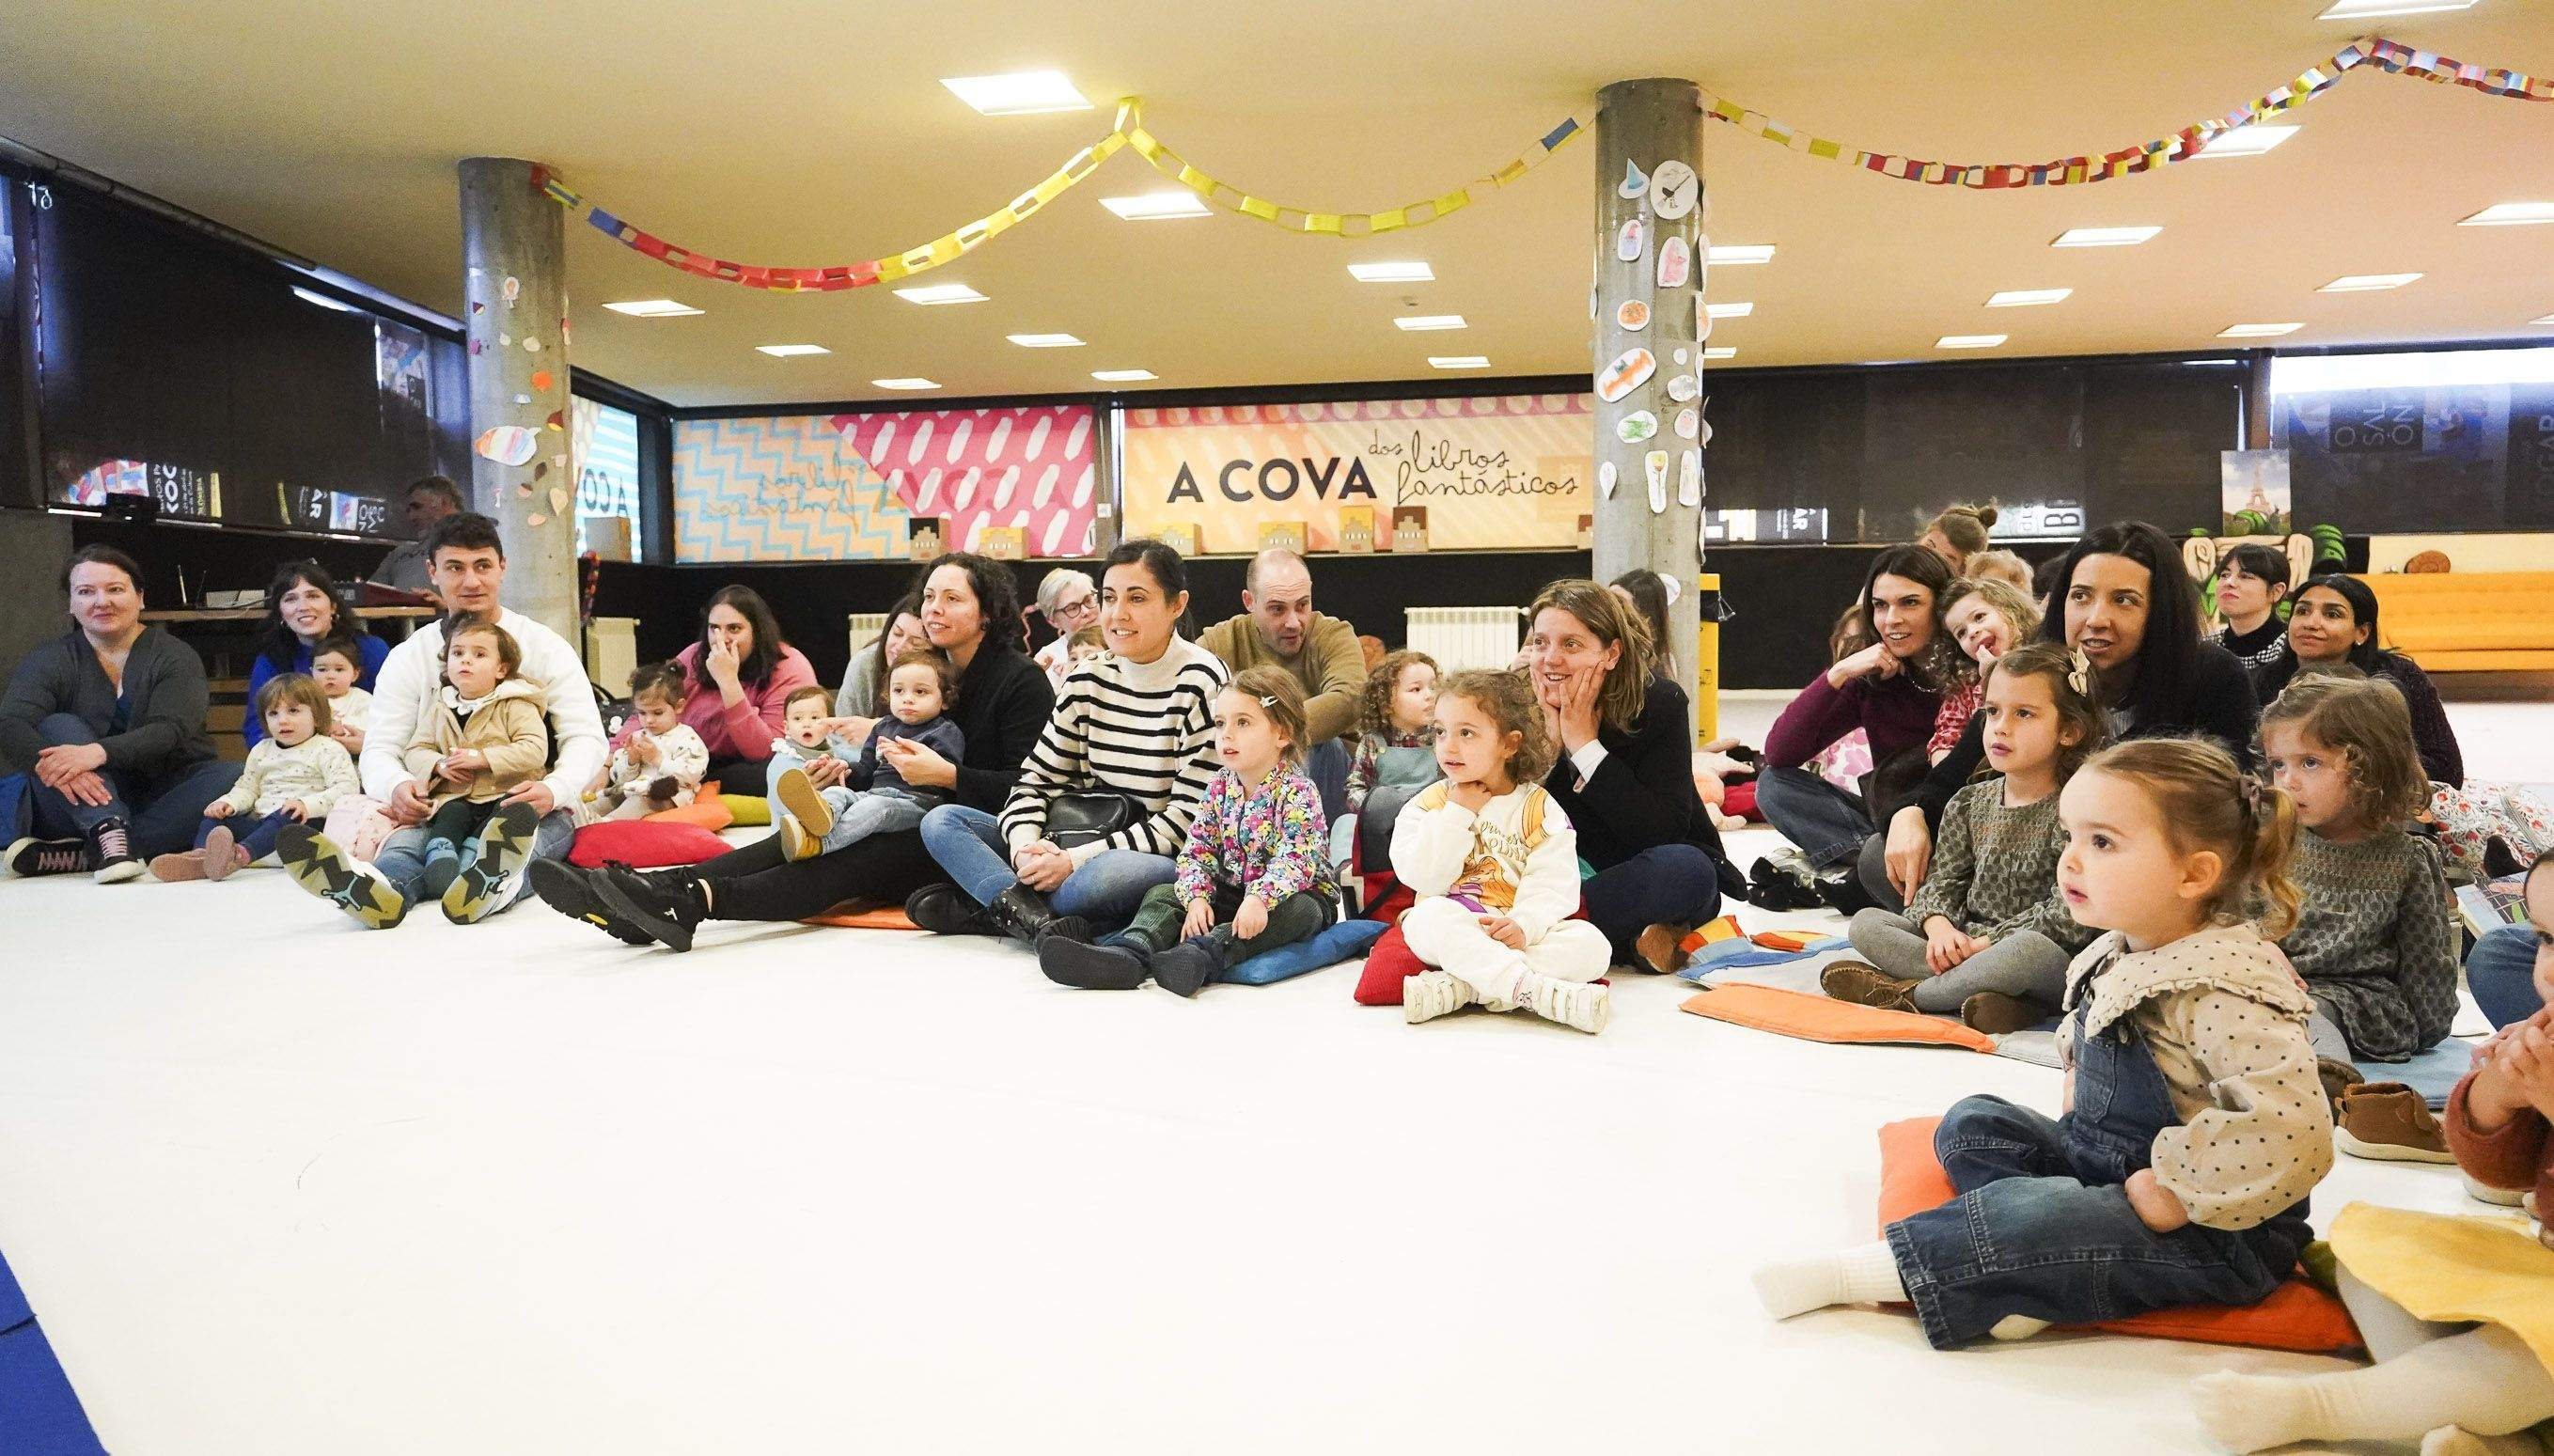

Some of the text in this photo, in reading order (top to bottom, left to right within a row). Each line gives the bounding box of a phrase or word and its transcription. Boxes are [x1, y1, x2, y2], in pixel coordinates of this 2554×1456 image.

[1369, 429, 1509, 472] dos libros
[1167, 456, 1377, 503] A COVA
[1398, 461, 1578, 505] fantásticos
